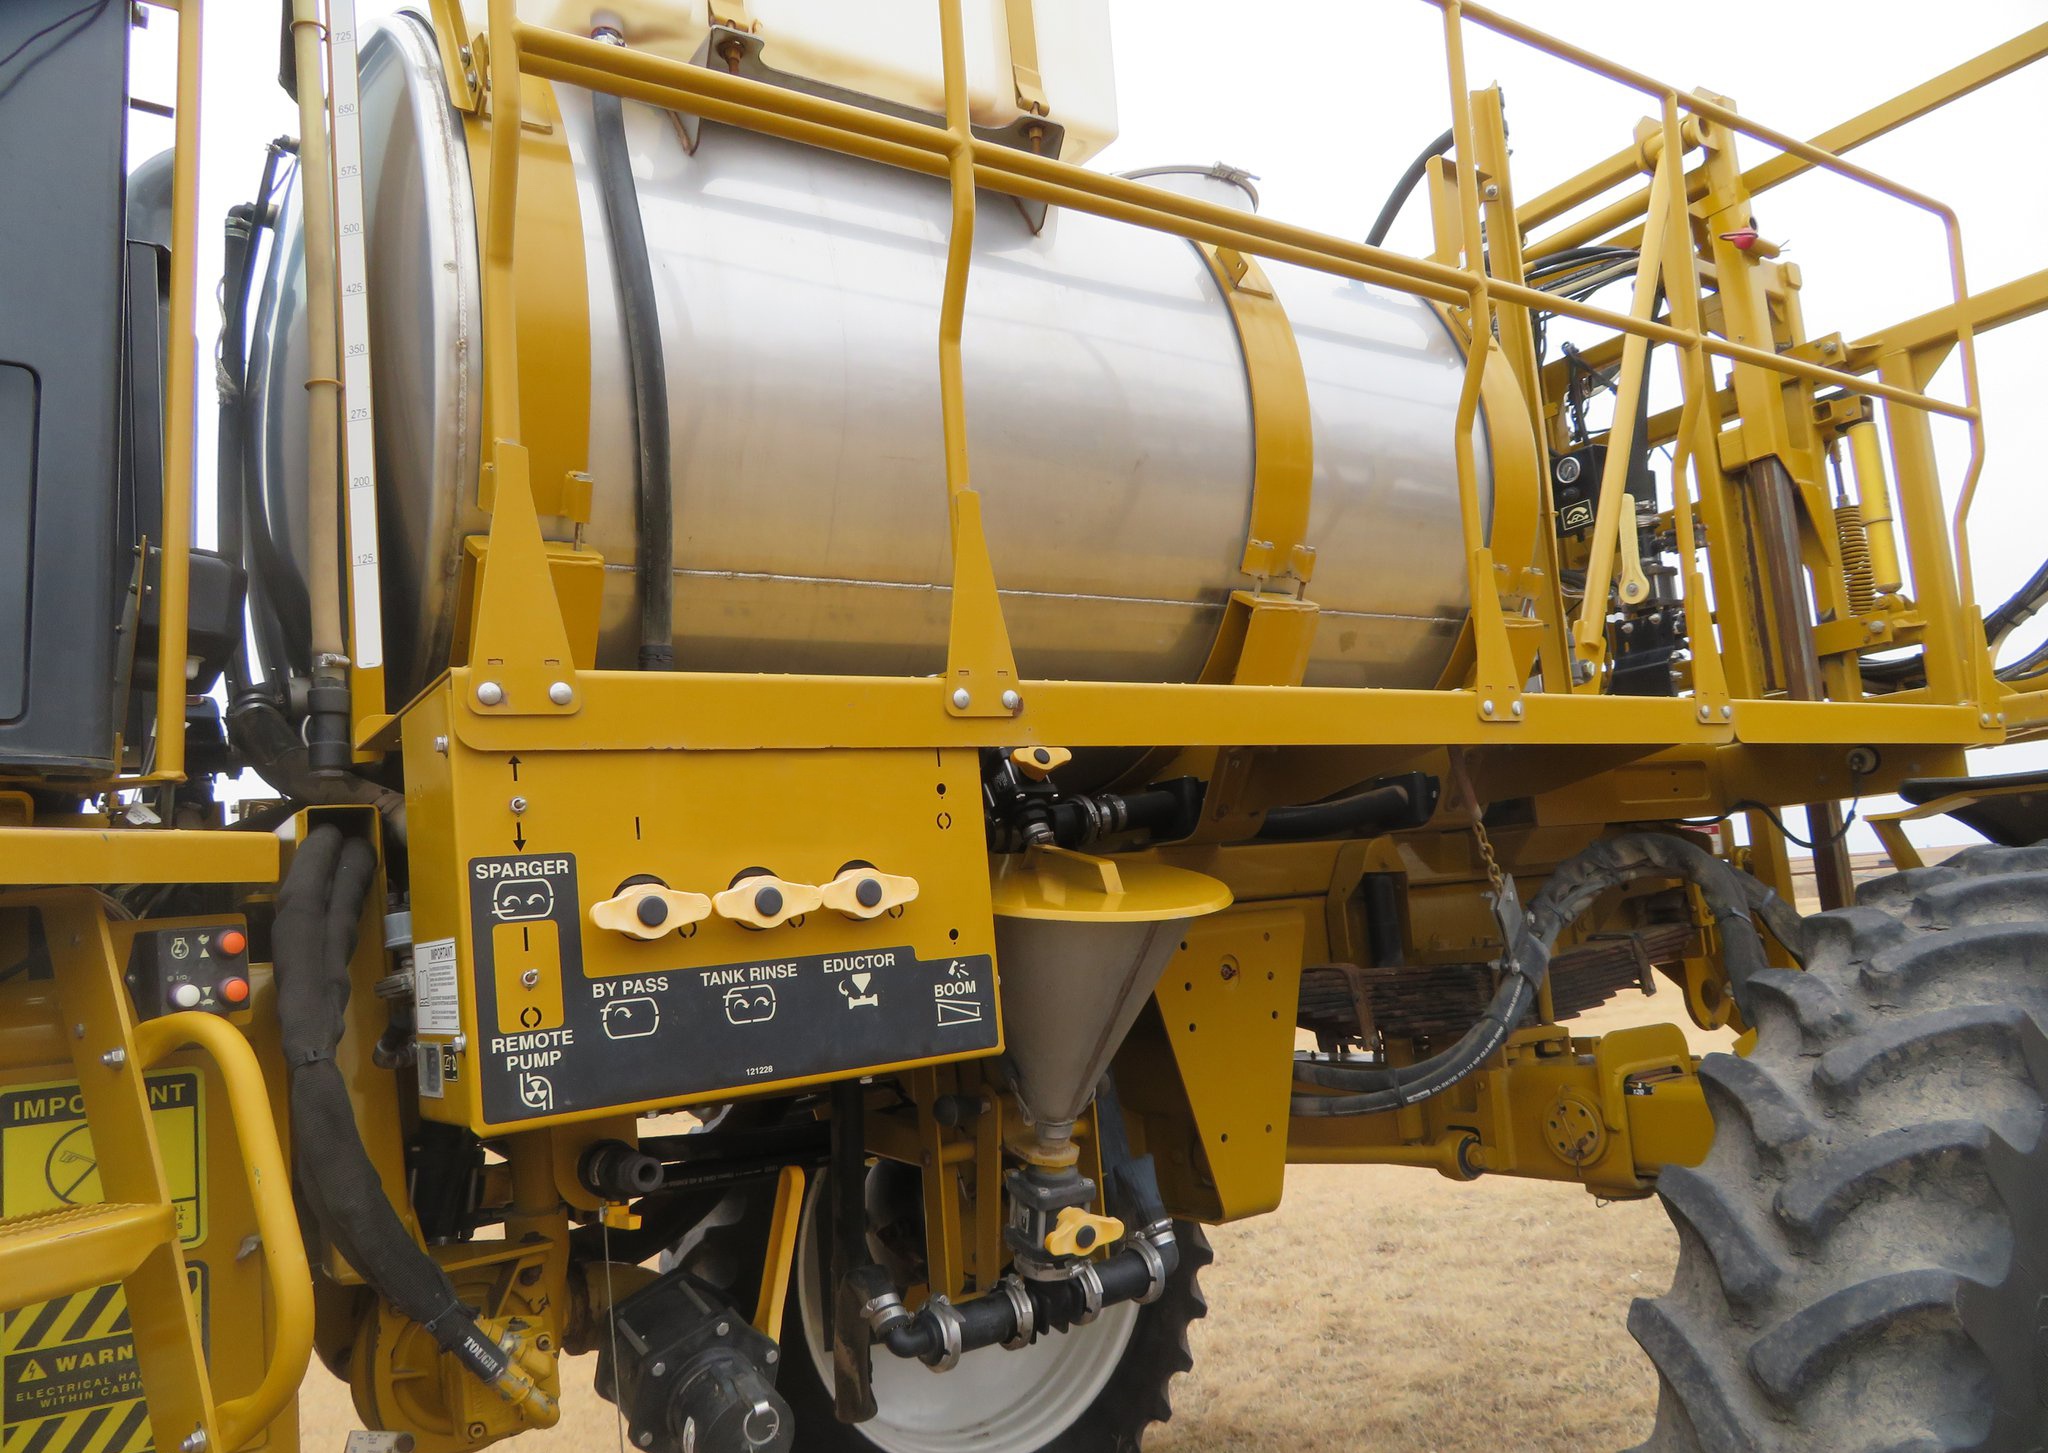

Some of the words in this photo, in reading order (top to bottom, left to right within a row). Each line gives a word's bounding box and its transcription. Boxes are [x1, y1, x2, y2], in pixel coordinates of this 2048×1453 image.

[335, 31, 352, 41] 725
[338, 104, 355, 114] 650
[341, 166, 358, 175] 575
[343, 223, 360, 233] 500
[346, 283, 363, 293] 425
[348, 344, 365, 354] 350
[350, 408, 368, 418] 275
[353, 476, 370, 487] 200
[357, 553, 374, 564] 125
[475, 859, 569, 880] SPARGER
[823, 953, 896, 974] EDUCTOR
[700, 968, 745, 987] TANK
[750, 963, 798, 982] RINSE
[592, 981, 617, 999] BY
[622, 976, 669, 994] PASS
[934, 980, 977, 997] BOOM
[491, 1029, 574, 1054] REMOTE
[506, 1050, 562, 1072] PUMP
[746, 1065, 773, 1076] 121228
[55, 1344, 134, 1374] WARN
[463, 1335, 499, 1372] TOUGH
[16, 1376, 112, 1402] ELECTRICAL
[40, 1390, 94, 1408] WITHIN
